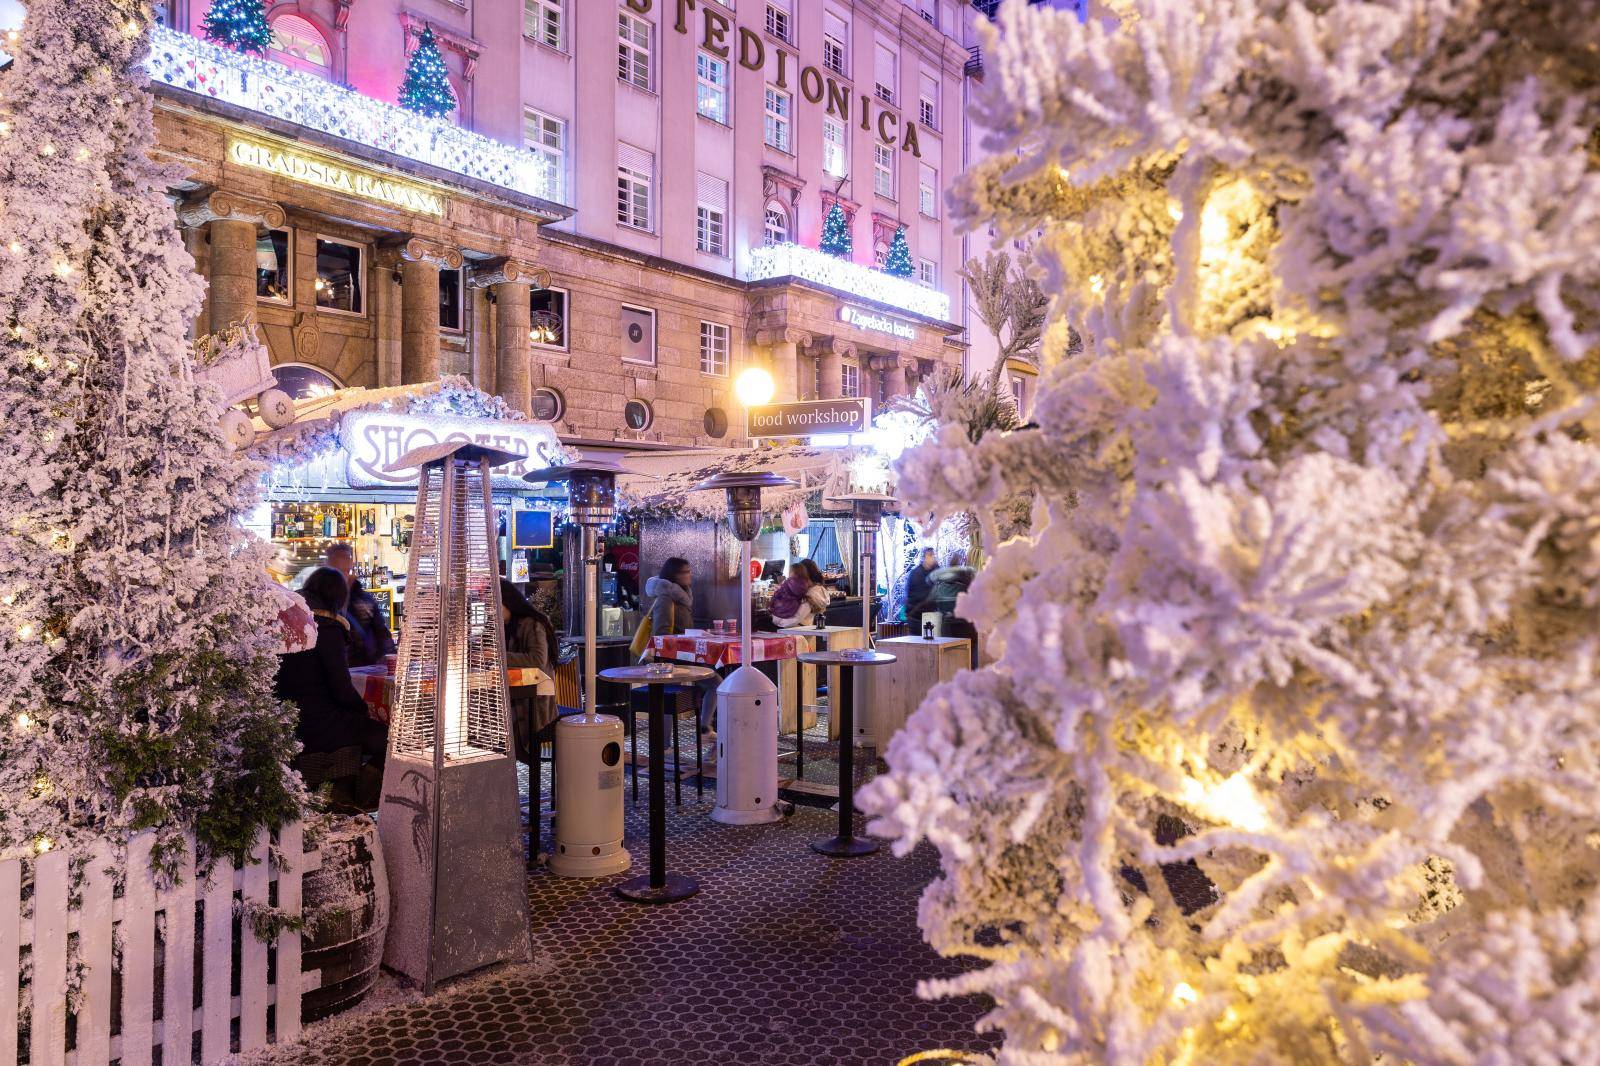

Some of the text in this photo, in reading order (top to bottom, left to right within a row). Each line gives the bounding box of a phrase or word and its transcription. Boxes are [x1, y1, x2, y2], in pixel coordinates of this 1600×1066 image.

[627, 0, 921, 157] TEDIONICA
[234, 142, 355, 192] GRADSKA
[753, 408, 858, 427] food workshop
